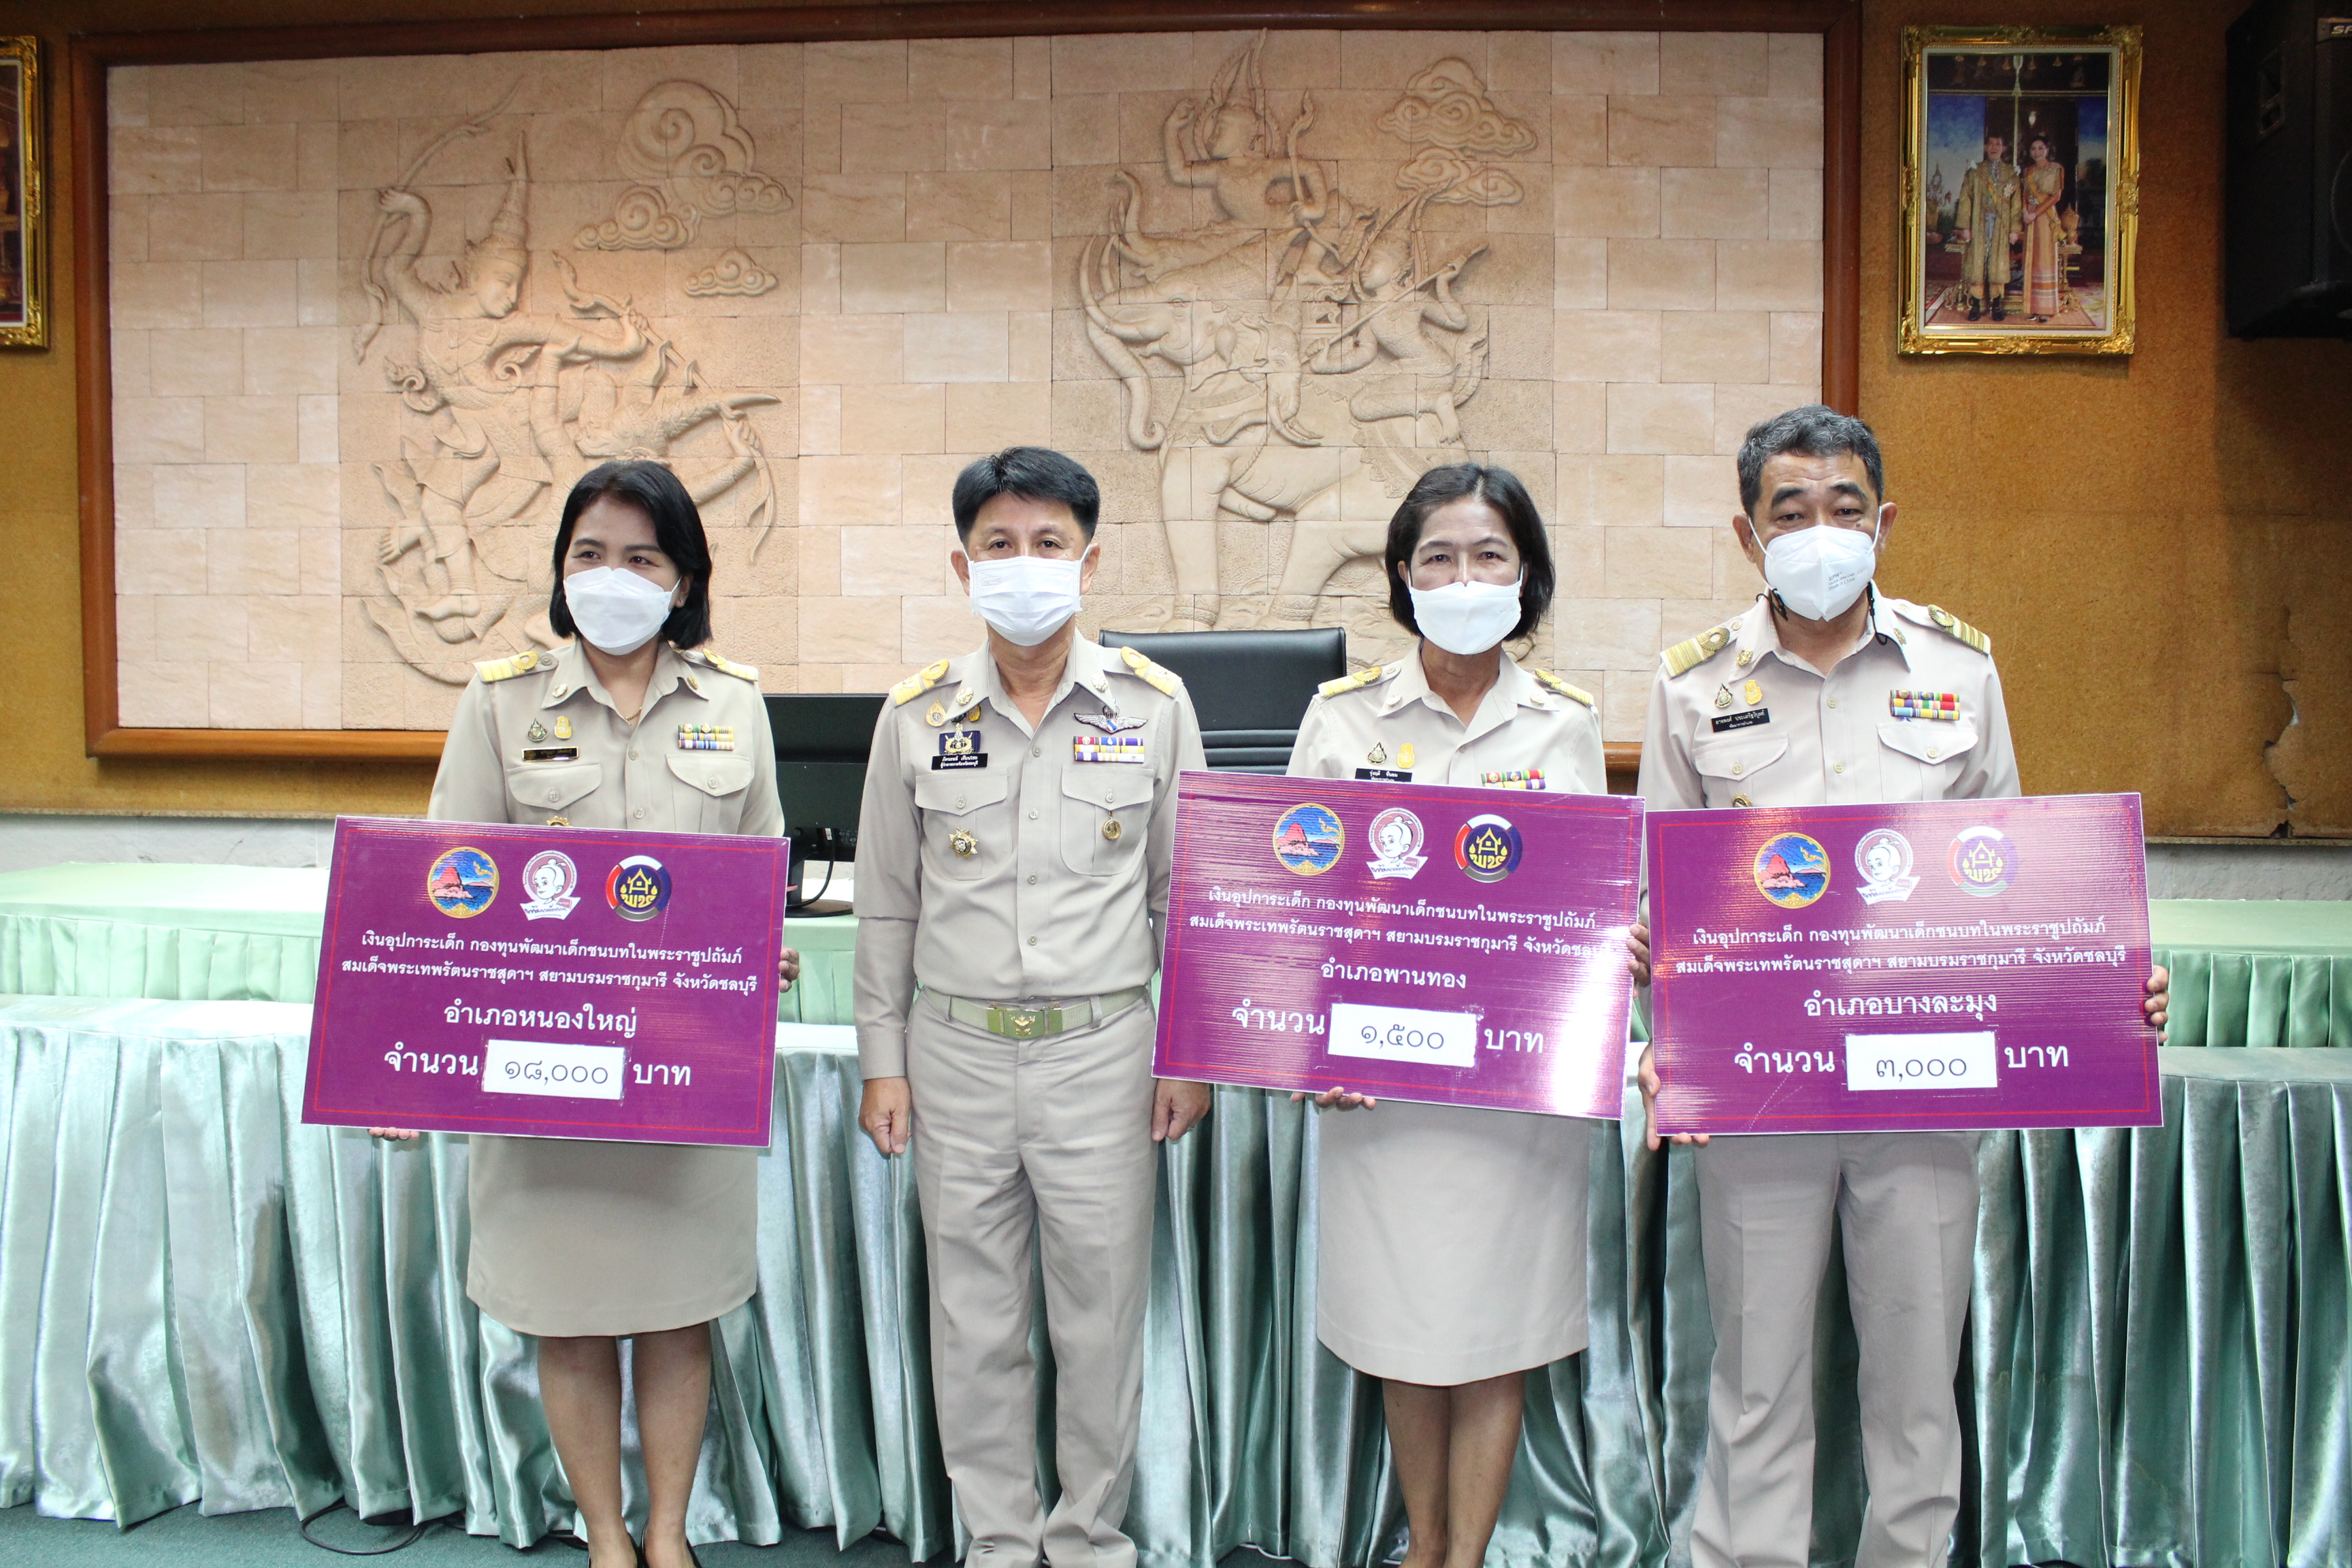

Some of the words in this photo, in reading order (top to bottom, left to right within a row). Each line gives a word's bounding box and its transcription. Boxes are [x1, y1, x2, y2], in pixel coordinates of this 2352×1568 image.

[1209, 887, 1310, 908] เงินอุปการะเด็ก
[1317, 898, 1595, 930] กองทุนพัฒนาเด็กชนบทในพระราชูปถัมภ์
[363, 930, 463, 951] เงินอุปการะเด็ก
[471, 938, 742, 966] กองทุนพัฒนาเด็กชนบทในพระราชูปถัมภ์
[1190, 912, 1380, 943] สมเด็จพระเทพรัตนราชสุดาฯ
[1386, 931, 1518, 954] สยามบรมราชกุมารี
[1524, 936, 1611, 958] จังหวัดชล
[1694, 924, 1802, 949] เงินอุปการะเด็ก
[1810, 916, 2106, 946] กองทุนพัฒนาเด็กชนบทในพระราชูปถัมภ์
[342, 956, 533, 984] สมเด็จพระเทพรัตนราชสุดาฯ
[540, 970, 667, 991] สยามบรมราชกุมารี
[673, 973, 757, 996] จังหวัดชลบุรี
[1321, 957, 1466, 988] อำเภอพานทอง
[1676, 955, 1880, 974] สมเด็จพระเทพรัตนราชสุดาฯ
[1887, 949, 2026, 971] สยามบรมราชกุมารี
[2033, 945, 2126, 967] จังหวัดชลบุรี
[444, 998, 636, 1038] อำเภอหนองใหญ่
[1804, 990, 1996, 1021] อำเภอบางละมุง
[1232, 998, 1324, 1034] จำนวน
[1362, 1025, 1444, 1050] ๑,๕๐๐
[1484, 1029, 1543, 1053] บาท
[385, 1042, 478, 1075] จำนวน
[506, 1060, 608, 1085] ๑๘,๐๐๐
[634, 1064, 690, 1085] บาท
[1735, 1043, 1835, 1073] จำนวน
[1877, 1059, 1967, 1080] ๓,๐๐๐
[2004, 1046, 2068, 1068] บาท
